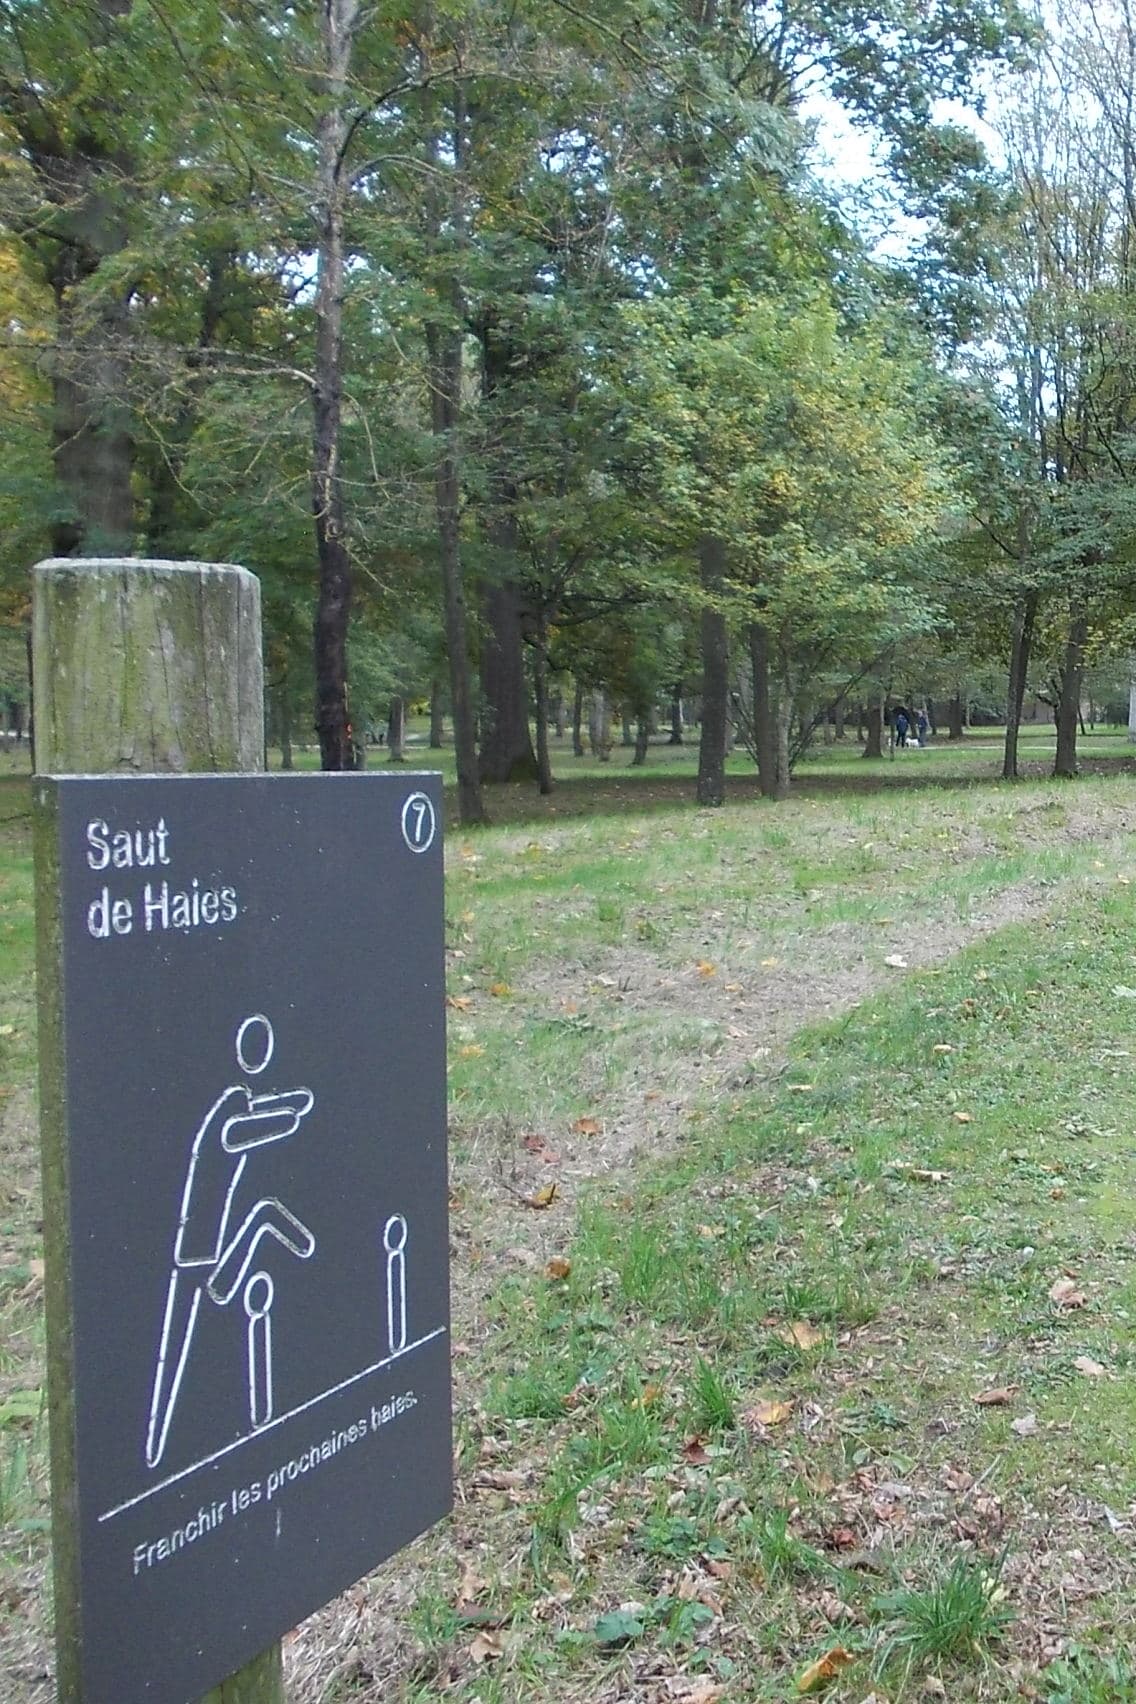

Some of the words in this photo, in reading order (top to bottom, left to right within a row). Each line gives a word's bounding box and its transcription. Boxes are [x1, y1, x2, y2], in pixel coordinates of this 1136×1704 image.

[86, 816, 171, 871] Saut
[412, 802, 427, 843] 7
[86, 886, 133, 939] de
[144, 878, 238, 932] Haies
[132, 1501, 228, 1575] Franchir
[232, 1479, 262, 1515] les
[266, 1417, 367, 1500] prochaines
